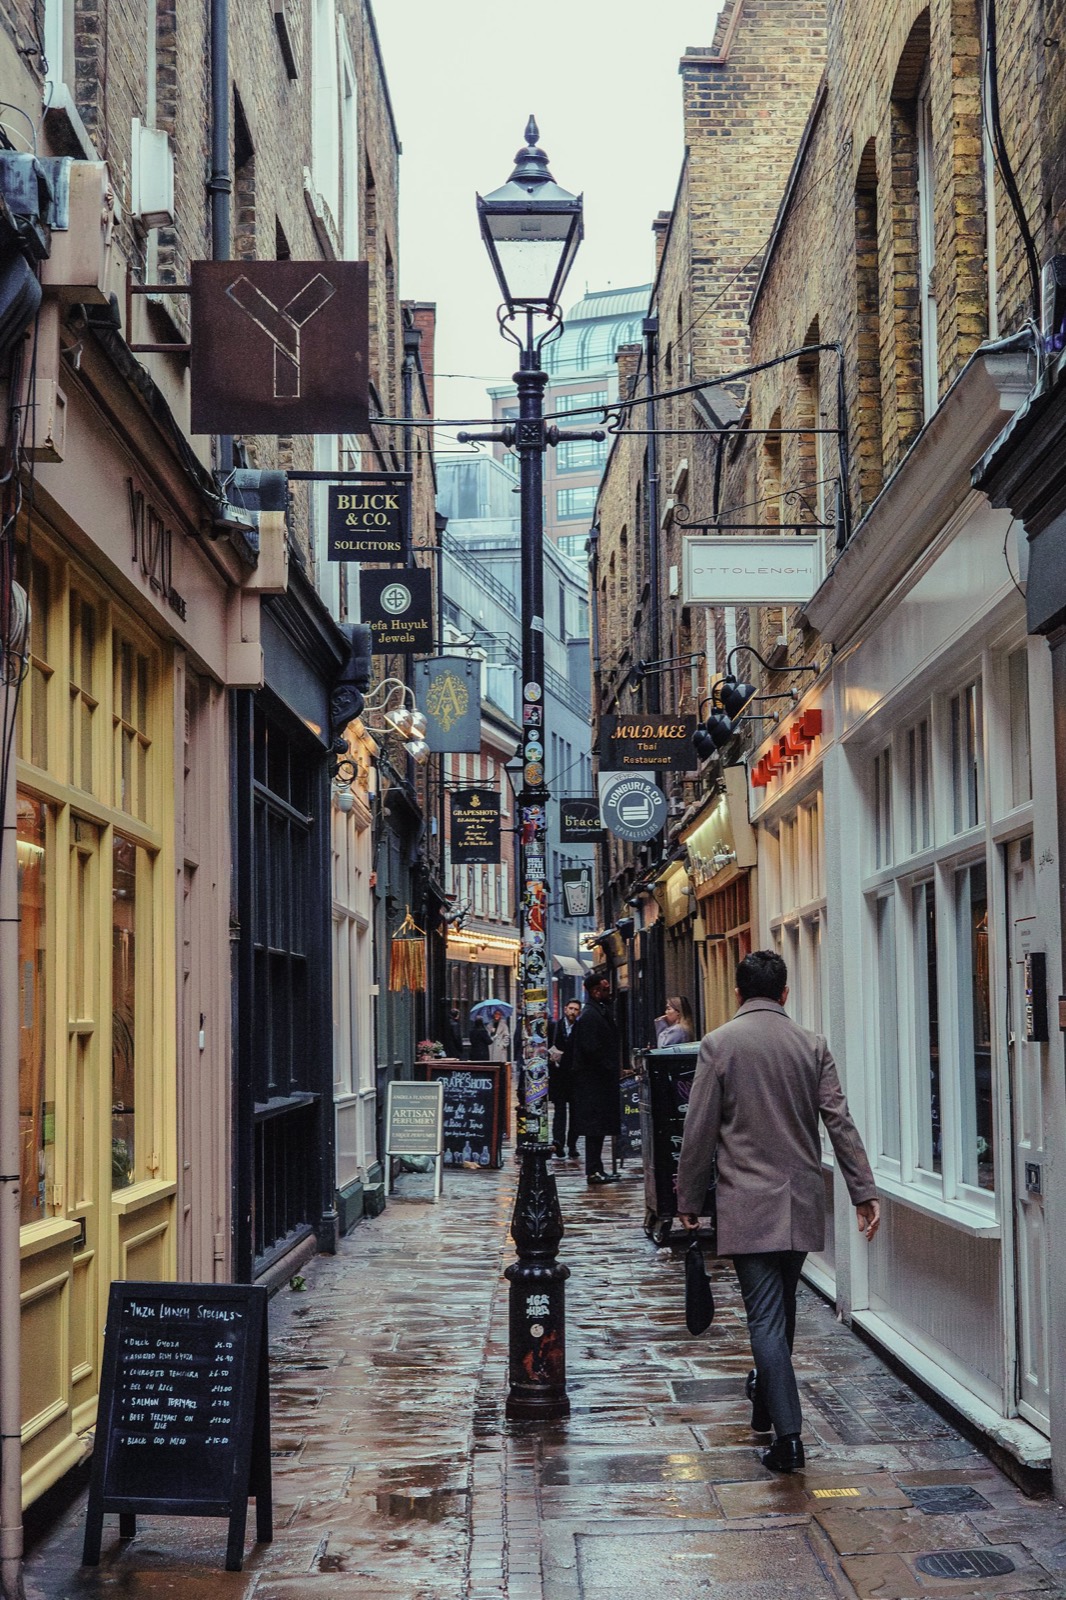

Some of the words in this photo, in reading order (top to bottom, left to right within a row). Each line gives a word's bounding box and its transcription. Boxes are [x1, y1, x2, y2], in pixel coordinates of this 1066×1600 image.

[226, 273, 337, 398] Y
[336, 494, 400, 510] BLICK
[345, 512, 358, 526] &
[362, 512, 392, 526] CO.
[334, 540, 401, 551] SOLICITORS
[693, 567, 812, 575] OTTOLENGHI
[390, 618, 428, 632] Huyuk
[378, 632, 416, 644] Jewels
[610, 724, 687, 739] MUDMEE
[637, 742, 658, 751] Thai
[623, 756, 672, 764] Restaurant
[608, 781, 644, 808] DONBURI
[643, 784, 652, 794] &
[650, 790, 662, 806] CO
[565, 815, 600, 826] brace
[614, 822, 659, 838] SPITALFIELDS
[160, 1304, 190, 1319] LUNCH
[197, 1305, 235, 1321] SPECIALS
[156, 1339, 180, 1348] GYOZA
[131, 1398, 159, 1406] SALMON
